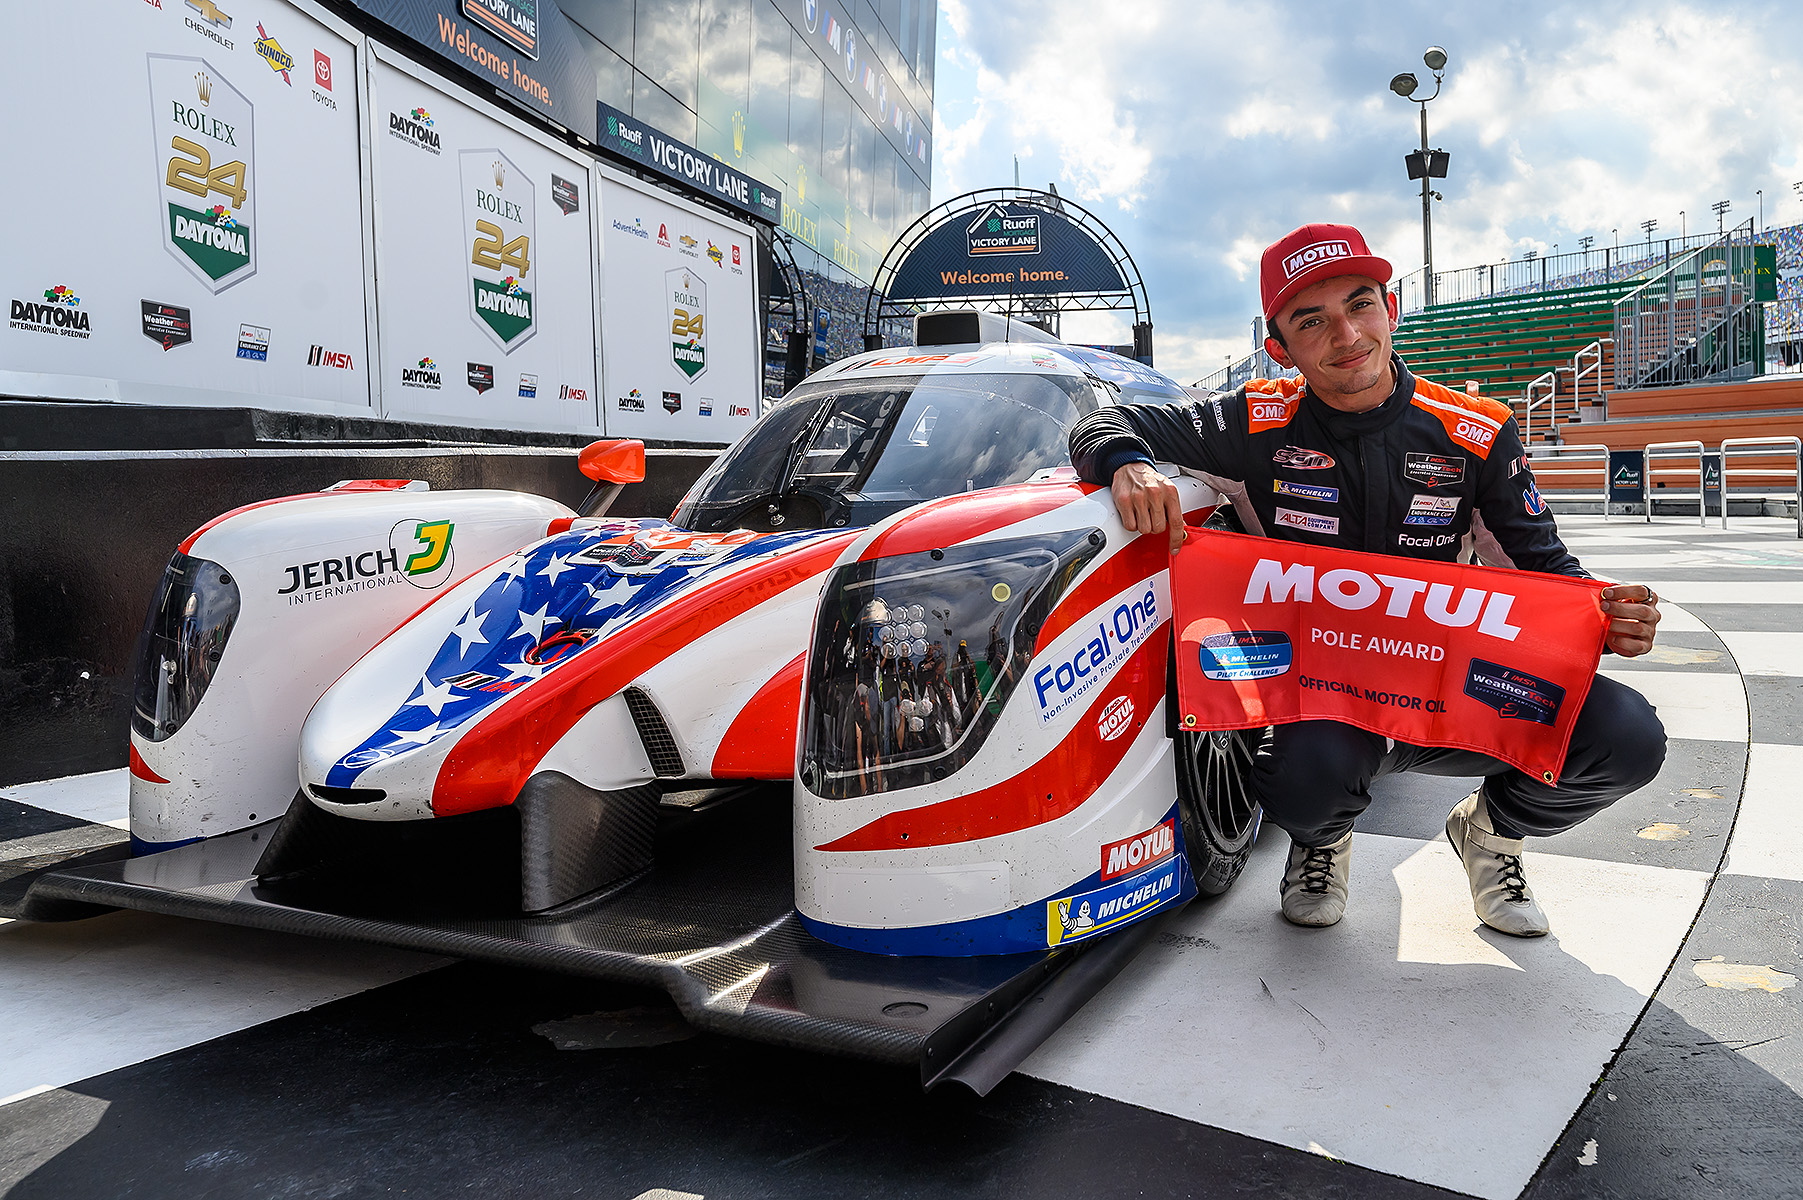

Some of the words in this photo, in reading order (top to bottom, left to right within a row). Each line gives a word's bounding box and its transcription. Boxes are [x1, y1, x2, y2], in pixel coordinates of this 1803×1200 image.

[184, 17, 235, 50] CHEVROLET
[511, 7, 535, 38] LANE
[256, 39, 293, 69] SUNOCO
[437, 13, 510, 80] Welcome
[513, 59, 553, 107] home.
[311, 89, 338, 112] TOYOTA
[172, 100, 238, 148] ROLEX
[389, 111, 441, 150] DAYTONA
[618, 122, 643, 146] Ruoff
[166, 135, 248, 210] 24
[649, 135, 712, 186] VICTORY
[715, 167, 749, 205] LANE
[476, 188, 523, 224] ROLEX
[175, 214, 248, 257] DAYTONA
[612, 219, 649, 240] AdventHealth
[782, 202, 817, 247] ROLEX
[1002, 218, 1036, 230] Ruoff
[471, 219, 531, 279] 24
[833, 239, 860, 274] ROLEX
[970, 237, 1010, 248] VICTORY
[1012, 236, 1037, 246] LANE
[1289, 244, 1348, 273] MOTUL
[940, 269, 1015, 285] Welcome
[1020, 267, 1069, 282] home.
[478, 288, 531, 319] DAYTONA
[674, 291, 700, 308] ROLEX
[9, 299, 92, 332] DAYTONA
[9, 320, 59, 337] INTERNATIONAL
[60, 327, 91, 340] SPEEDWAY
[144, 314, 190, 329] WeatherTech
[671, 308, 704, 340] 24
[322, 350, 355, 371] IMSA
[674, 347, 704, 364] DAYTONA
[869, 353, 980, 368] LMP3
[402, 368, 442, 386] DAYTONA
[567, 388, 588, 401] IMSA
[618, 398, 646, 410] DAYTONA
[1252, 405, 1287, 419] OMP
[1456, 422, 1493, 445] OMP
[1408, 462, 1462, 474] WeatherTech
[1290, 486, 1333, 499] MICHELIN
[1279, 512, 1308, 527] ALTA
[277, 548, 399, 596] JERICH
[288, 575, 403, 606] INTERNATIONAL
[1243, 558, 1521, 642] MOTUL
[1238, 636, 1264, 644] IMSA
[1311, 627, 1362, 650] POLE
[1366, 636, 1445, 663] AWARD
[1042, 674, 1099, 723] Non-Invasive
[1099, 646, 1130, 676] Prostate
[1130, 615, 1159, 649] Treatment
[1230, 653, 1279, 663] MICHELIN
[1216, 671, 1238, 679] PILOT
[1239, 668, 1279, 677] CHALLENGE
[1511, 674, 1537, 688] IMSA
[1298, 674, 1363, 699] OFFICIAL
[1365, 688, 1422, 711] MOTOR
[1425, 699, 1447, 713] OIL
[1473, 673, 1556, 710] WeatherTech
[1098, 698, 1135, 740] MOTUL
[1106, 825, 1172, 875] MOTUL
[1097, 872, 1174, 920] MICHELIN
